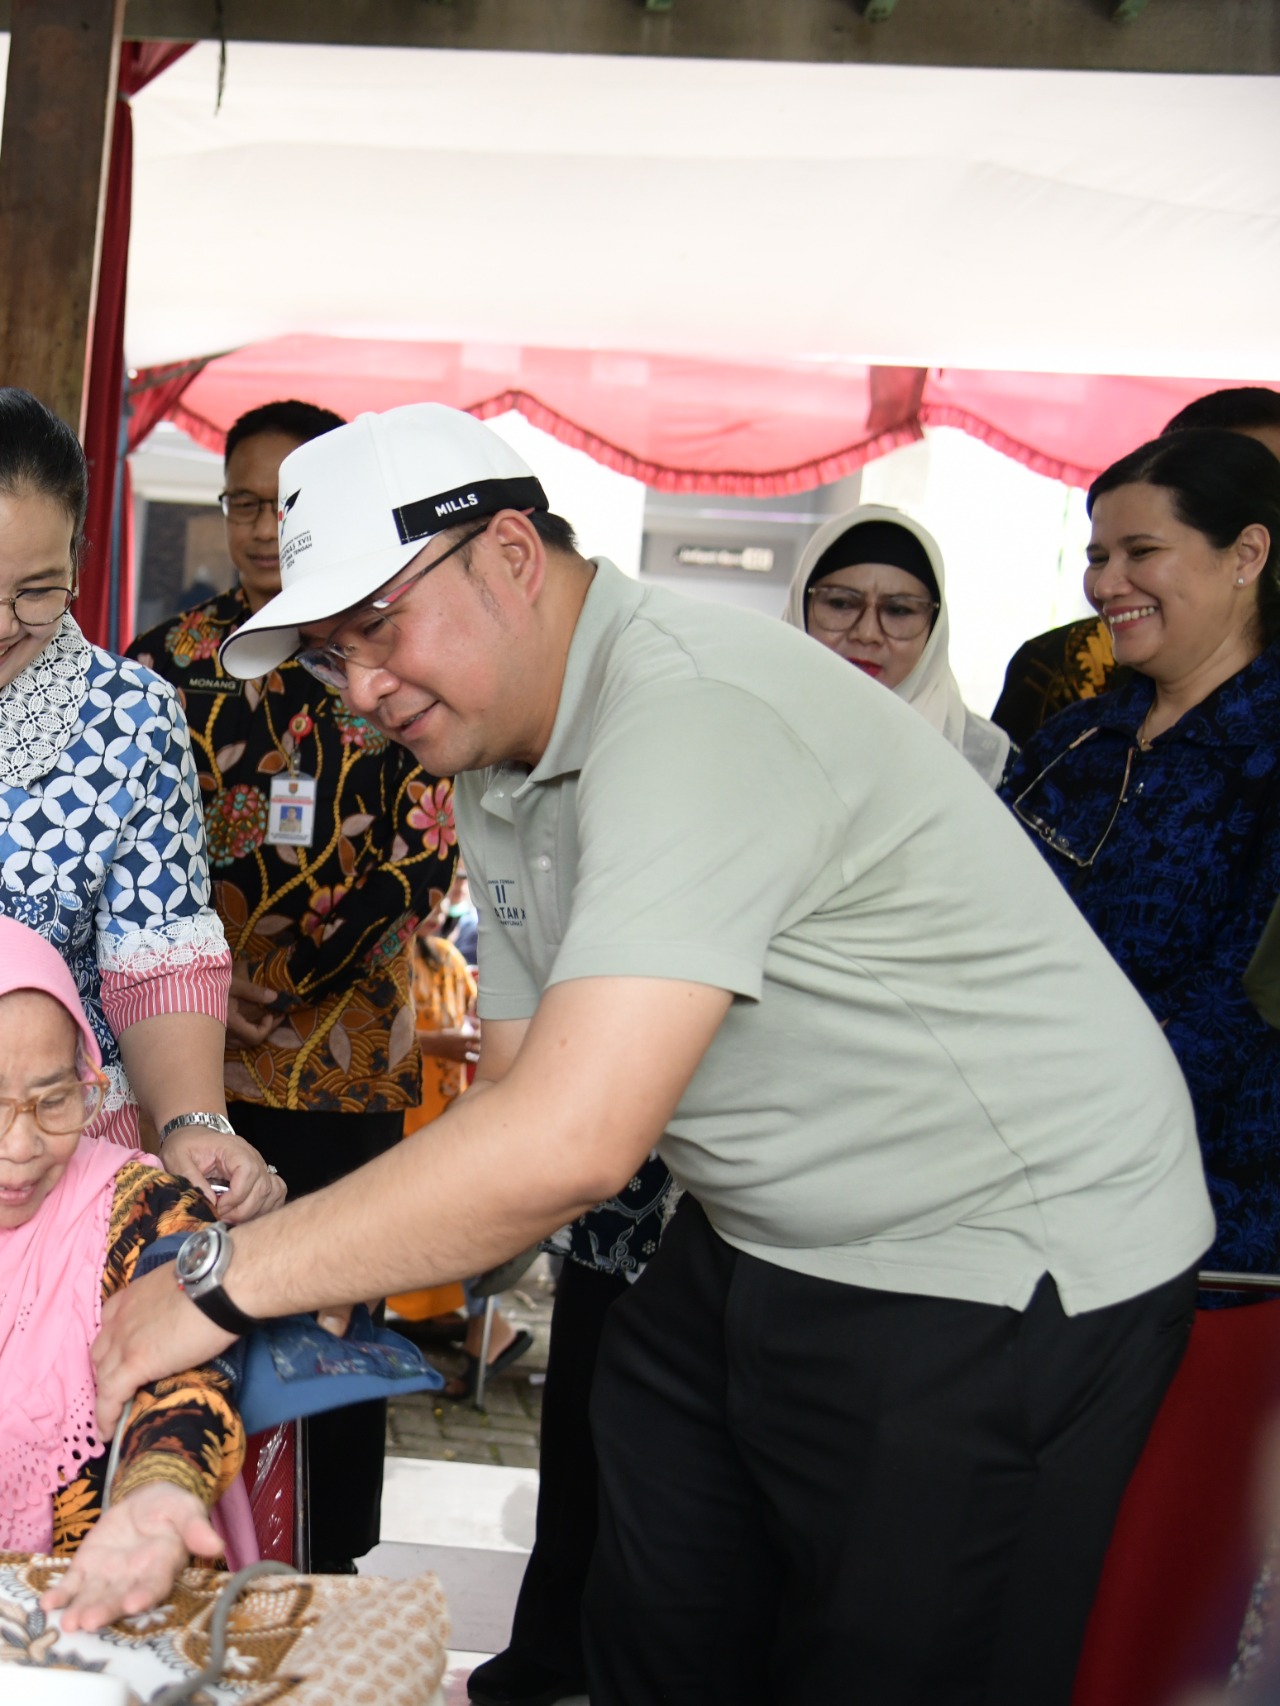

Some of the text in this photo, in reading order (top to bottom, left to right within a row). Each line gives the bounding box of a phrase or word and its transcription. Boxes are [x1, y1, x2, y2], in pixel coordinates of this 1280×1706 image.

[434, 493, 479, 517] MILLS
[297, 535, 312, 546] XVII
[188, 677, 237, 691] MONANG
